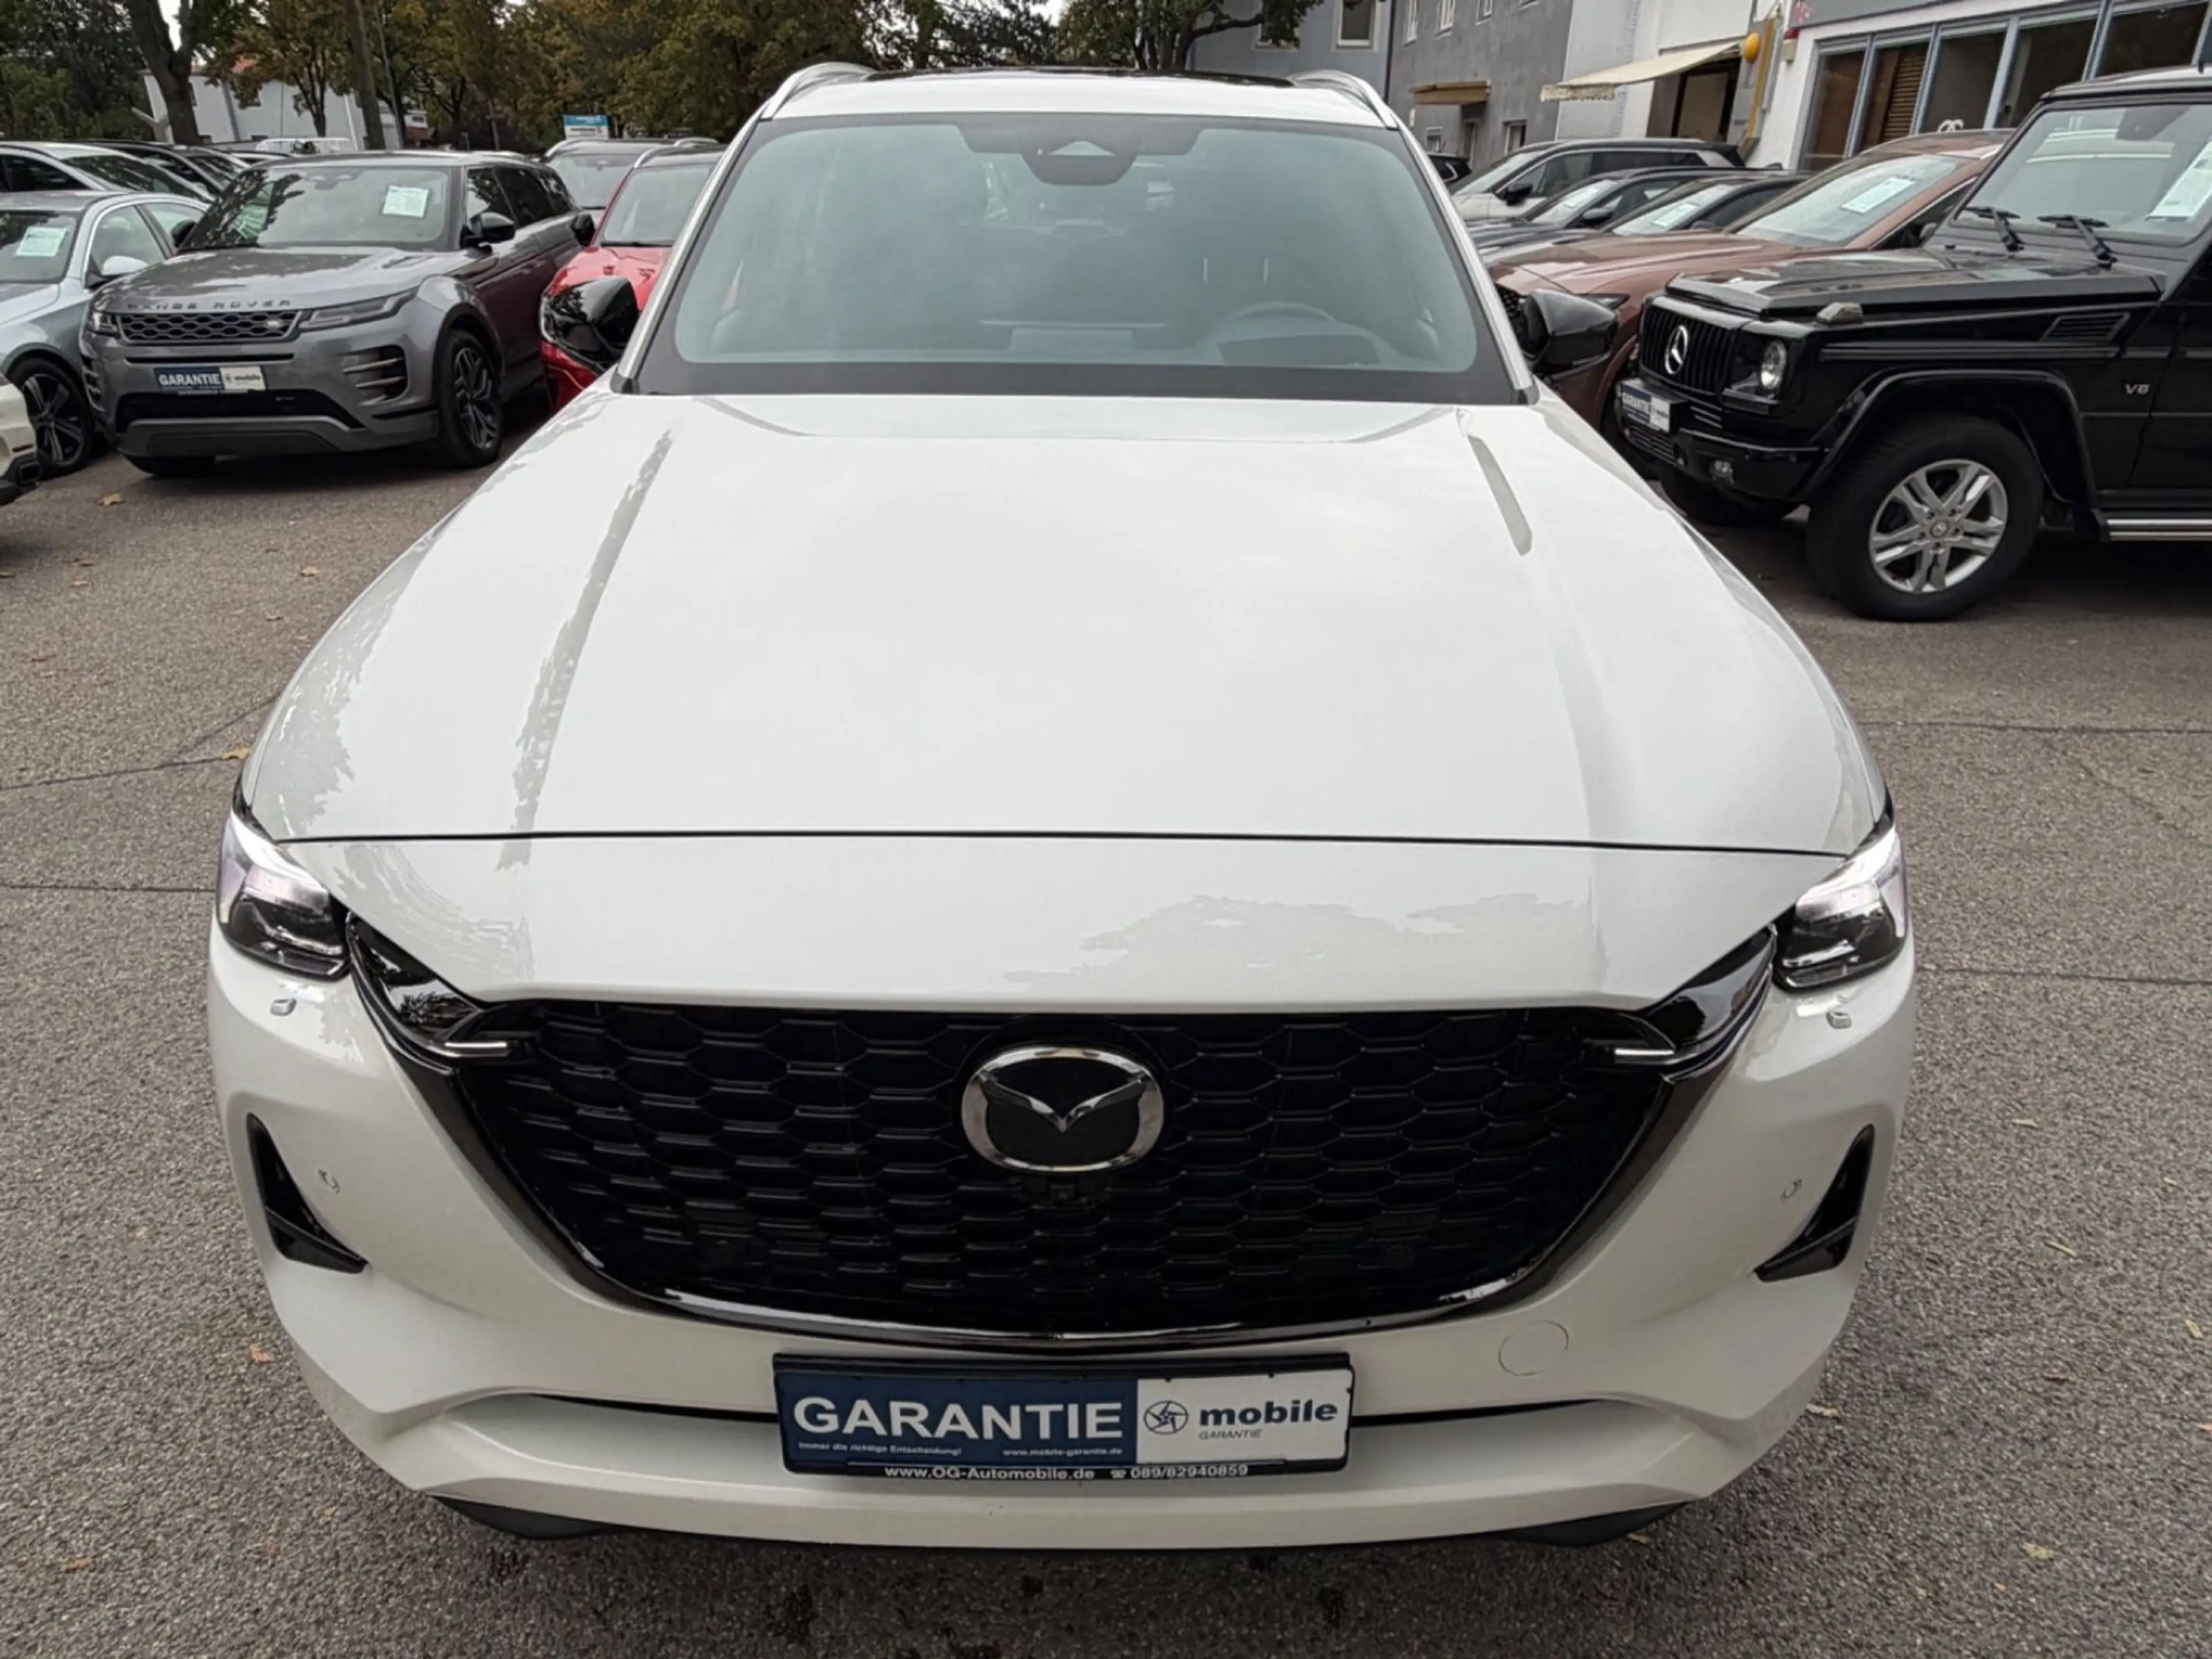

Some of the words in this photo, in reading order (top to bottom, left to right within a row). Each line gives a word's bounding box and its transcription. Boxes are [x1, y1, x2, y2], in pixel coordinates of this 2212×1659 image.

[158, 373, 222, 387] GARANTIE
[794, 1396, 1123, 1440] GARANTIE
[1200, 1399, 1338, 1426] mobile
[1199, 1428, 1263, 1440] GARANTIE
[833, 1442, 848, 1451] die
[884, 1466, 1095, 1480] www.OG-Automobile.de
